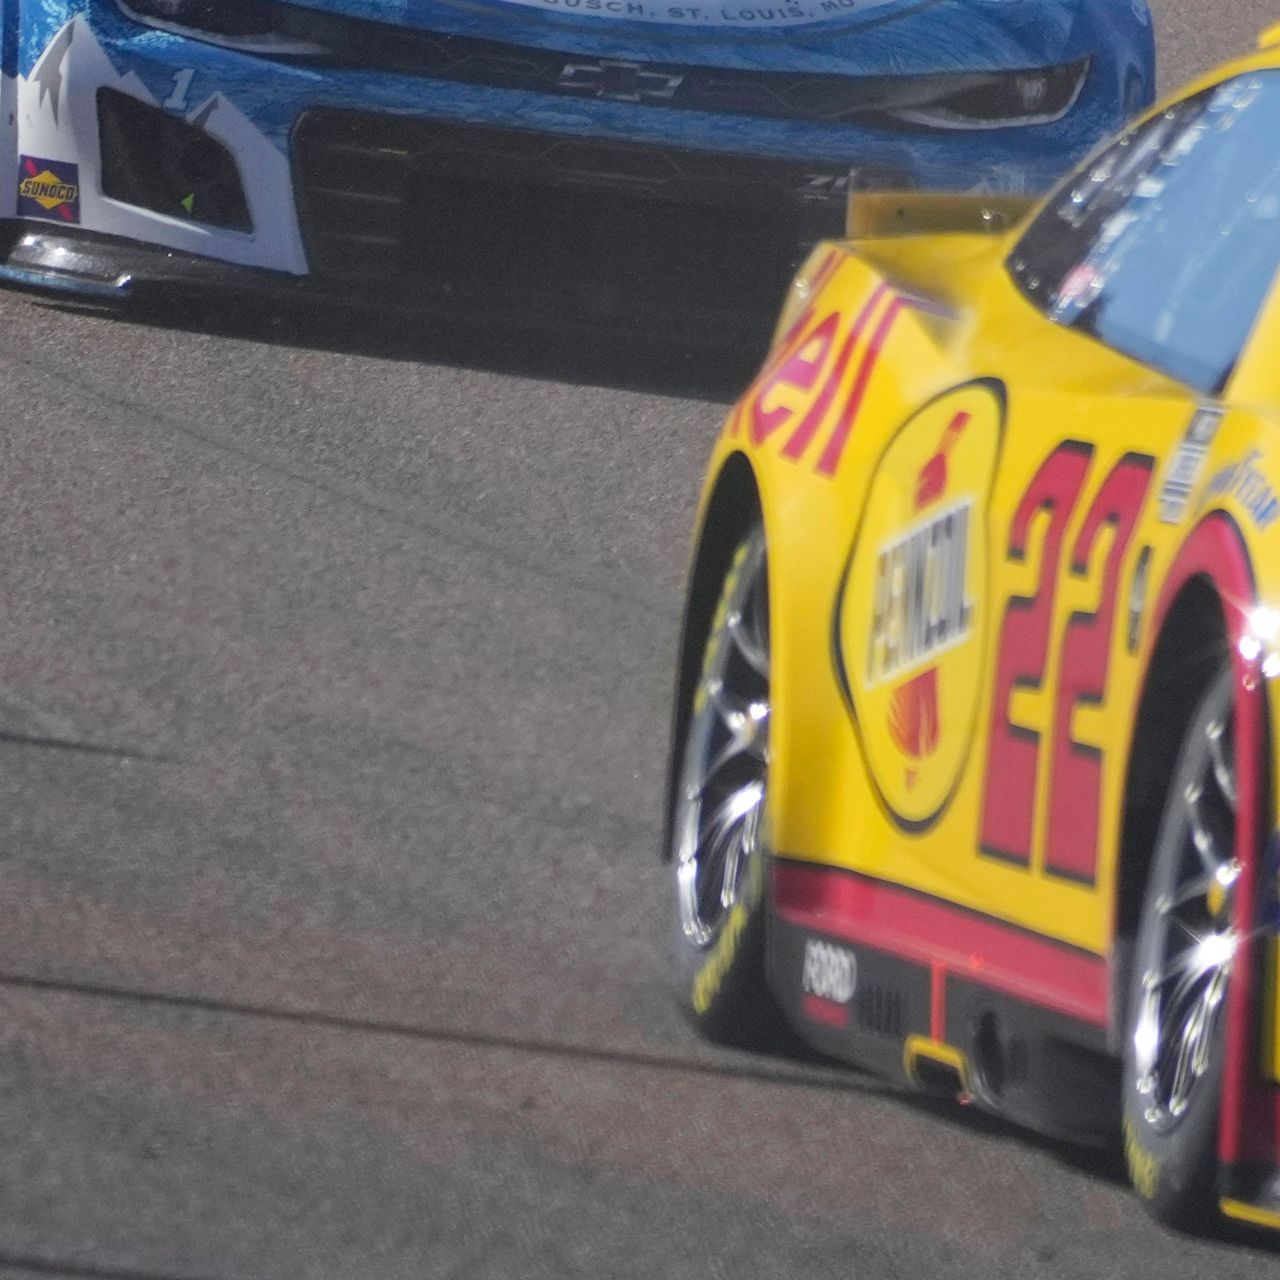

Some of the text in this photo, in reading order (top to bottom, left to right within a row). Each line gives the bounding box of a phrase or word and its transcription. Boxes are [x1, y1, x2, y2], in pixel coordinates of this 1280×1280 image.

[161, 68, 196, 110] 1
[21, 180, 77, 201] SUNOCO
[977, 438, 1156, 890] 22
